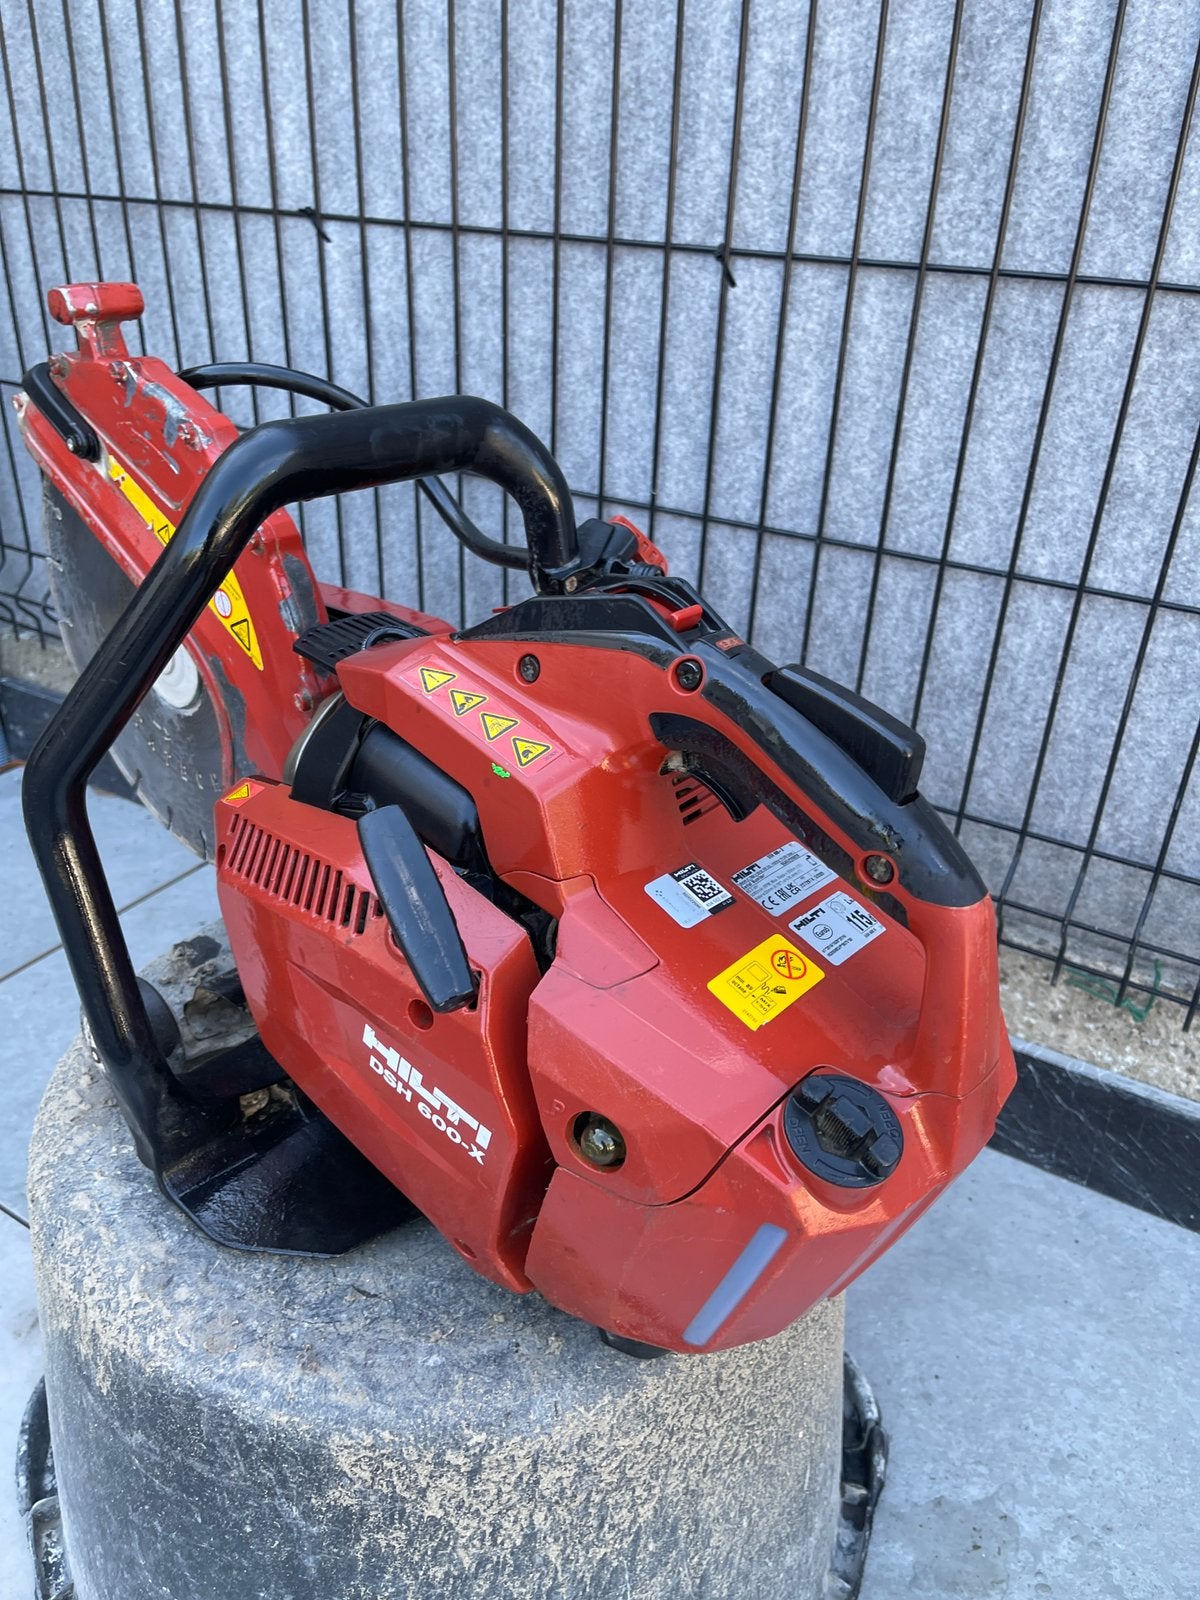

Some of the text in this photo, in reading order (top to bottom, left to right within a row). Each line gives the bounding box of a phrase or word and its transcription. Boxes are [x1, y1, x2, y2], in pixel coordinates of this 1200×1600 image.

[674, 864, 696, 877] HILTI
[732, 863, 761, 883] HILTI
[785, 882, 795, 892] UK
[790, 885, 802, 896] CA
[761, 896, 779, 910] CE
[793, 908, 825, 930] HILTI
[362, 1023, 493, 1150] HILTI
[369, 1055, 486, 1165] DSH 600-X
[878, 1102, 900, 1139] OPEN
[788, 1117, 812, 1153] OPEN
